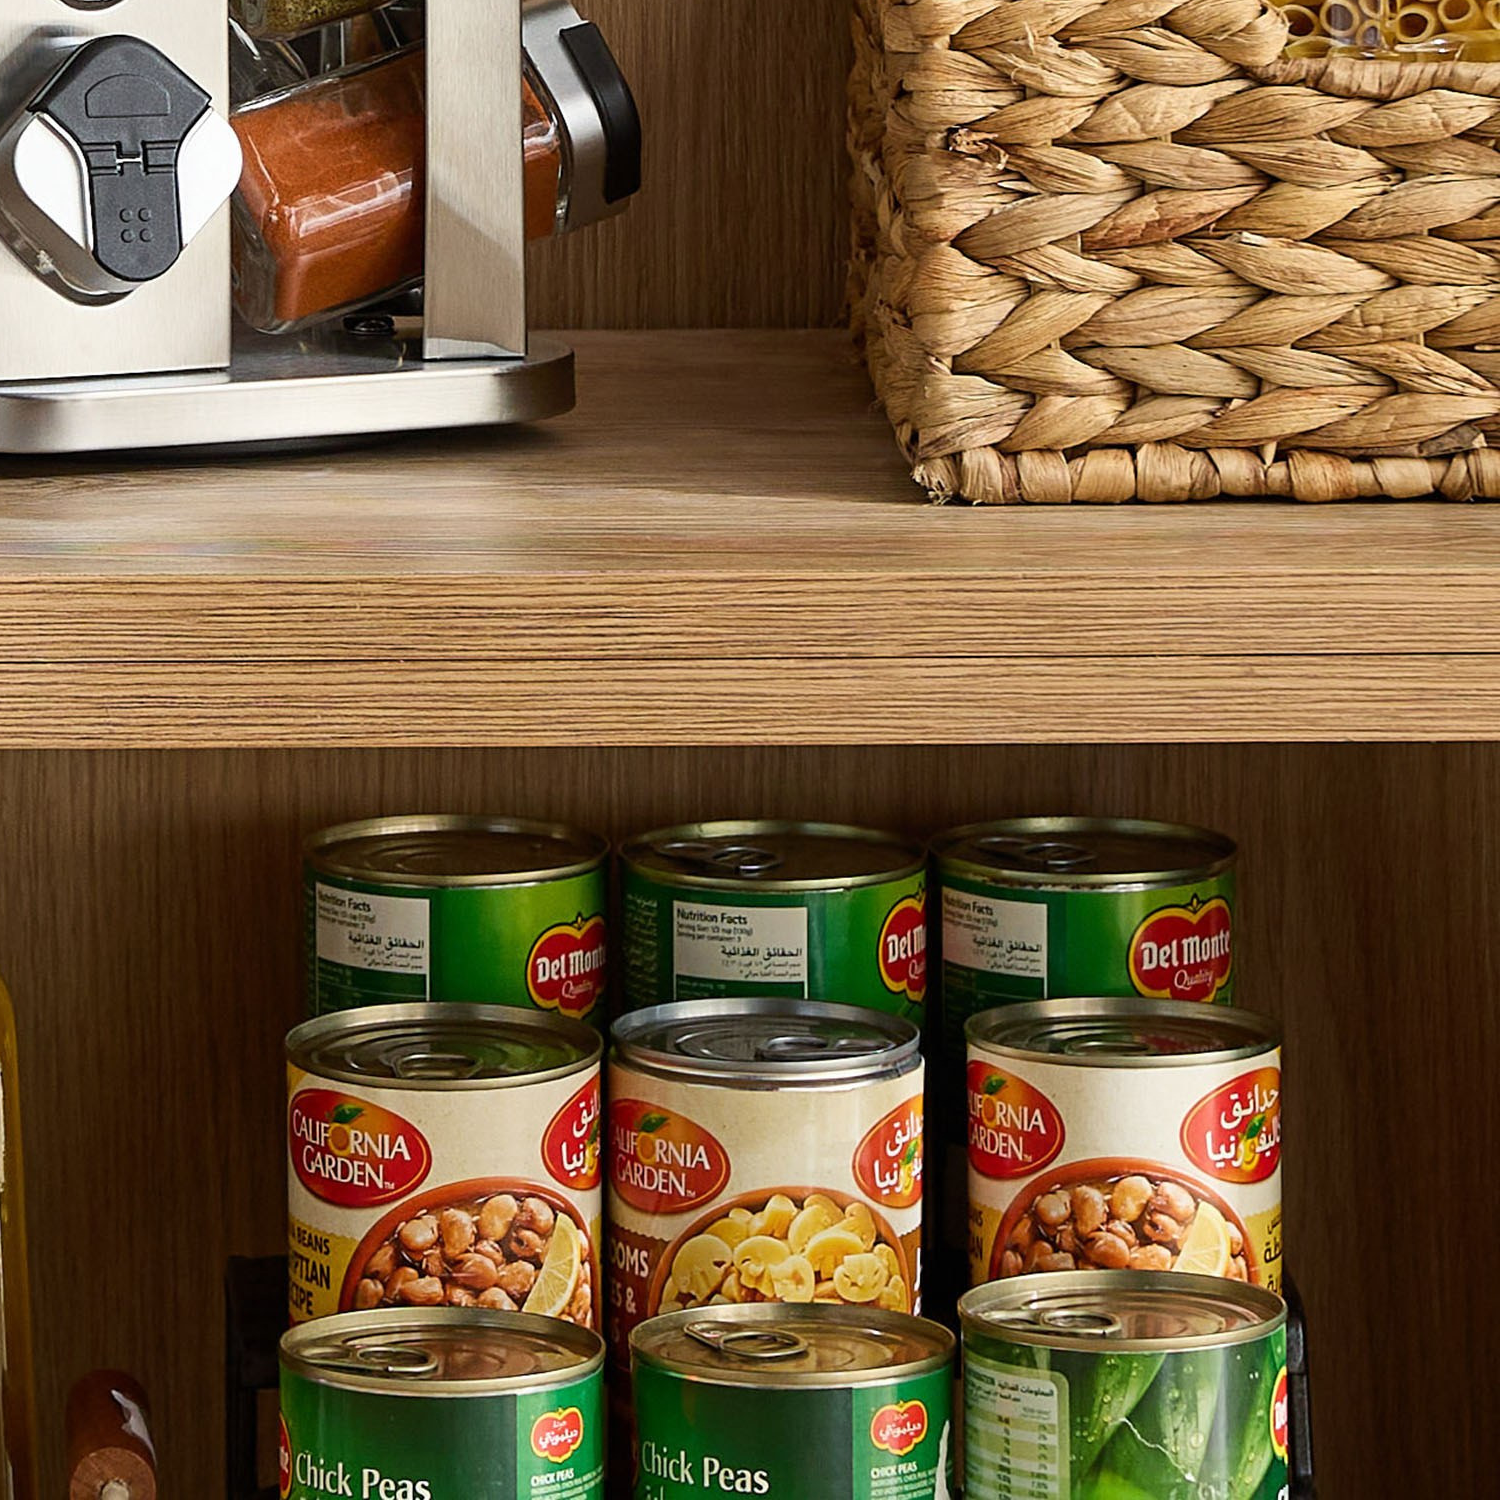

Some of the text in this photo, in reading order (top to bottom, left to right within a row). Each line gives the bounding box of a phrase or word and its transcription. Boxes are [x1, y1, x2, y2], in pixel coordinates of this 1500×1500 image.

[348, 897, 372, 913] Facts
[676, 908, 748, 926] Nutrition Facts
[972, 901, 994, 917] Facts
[721, 945, 803, 961] الحقائق الغذائية
[886, 929, 912, 964] Del
[1140, 928, 1230, 972] Del Monte
[536, 953, 566, 984] Del
[1174, 968, 1214, 991] Quality
[293, 1108, 411, 1161] CALIFORNIA
[612, 1124, 711, 1171] ALIFORNIA
[303, 1144, 384, 1189] GARDEN
[297, 1227, 330, 1256] BEANS
[296, 1450, 353, 1497] Chick
[362, 1468, 431, 1500] Peas
[556, 1467, 575, 1482] PEAS
[642, 1440, 770, 1494] Chick Peas
[898, 1460, 918, 1475] PEAS
